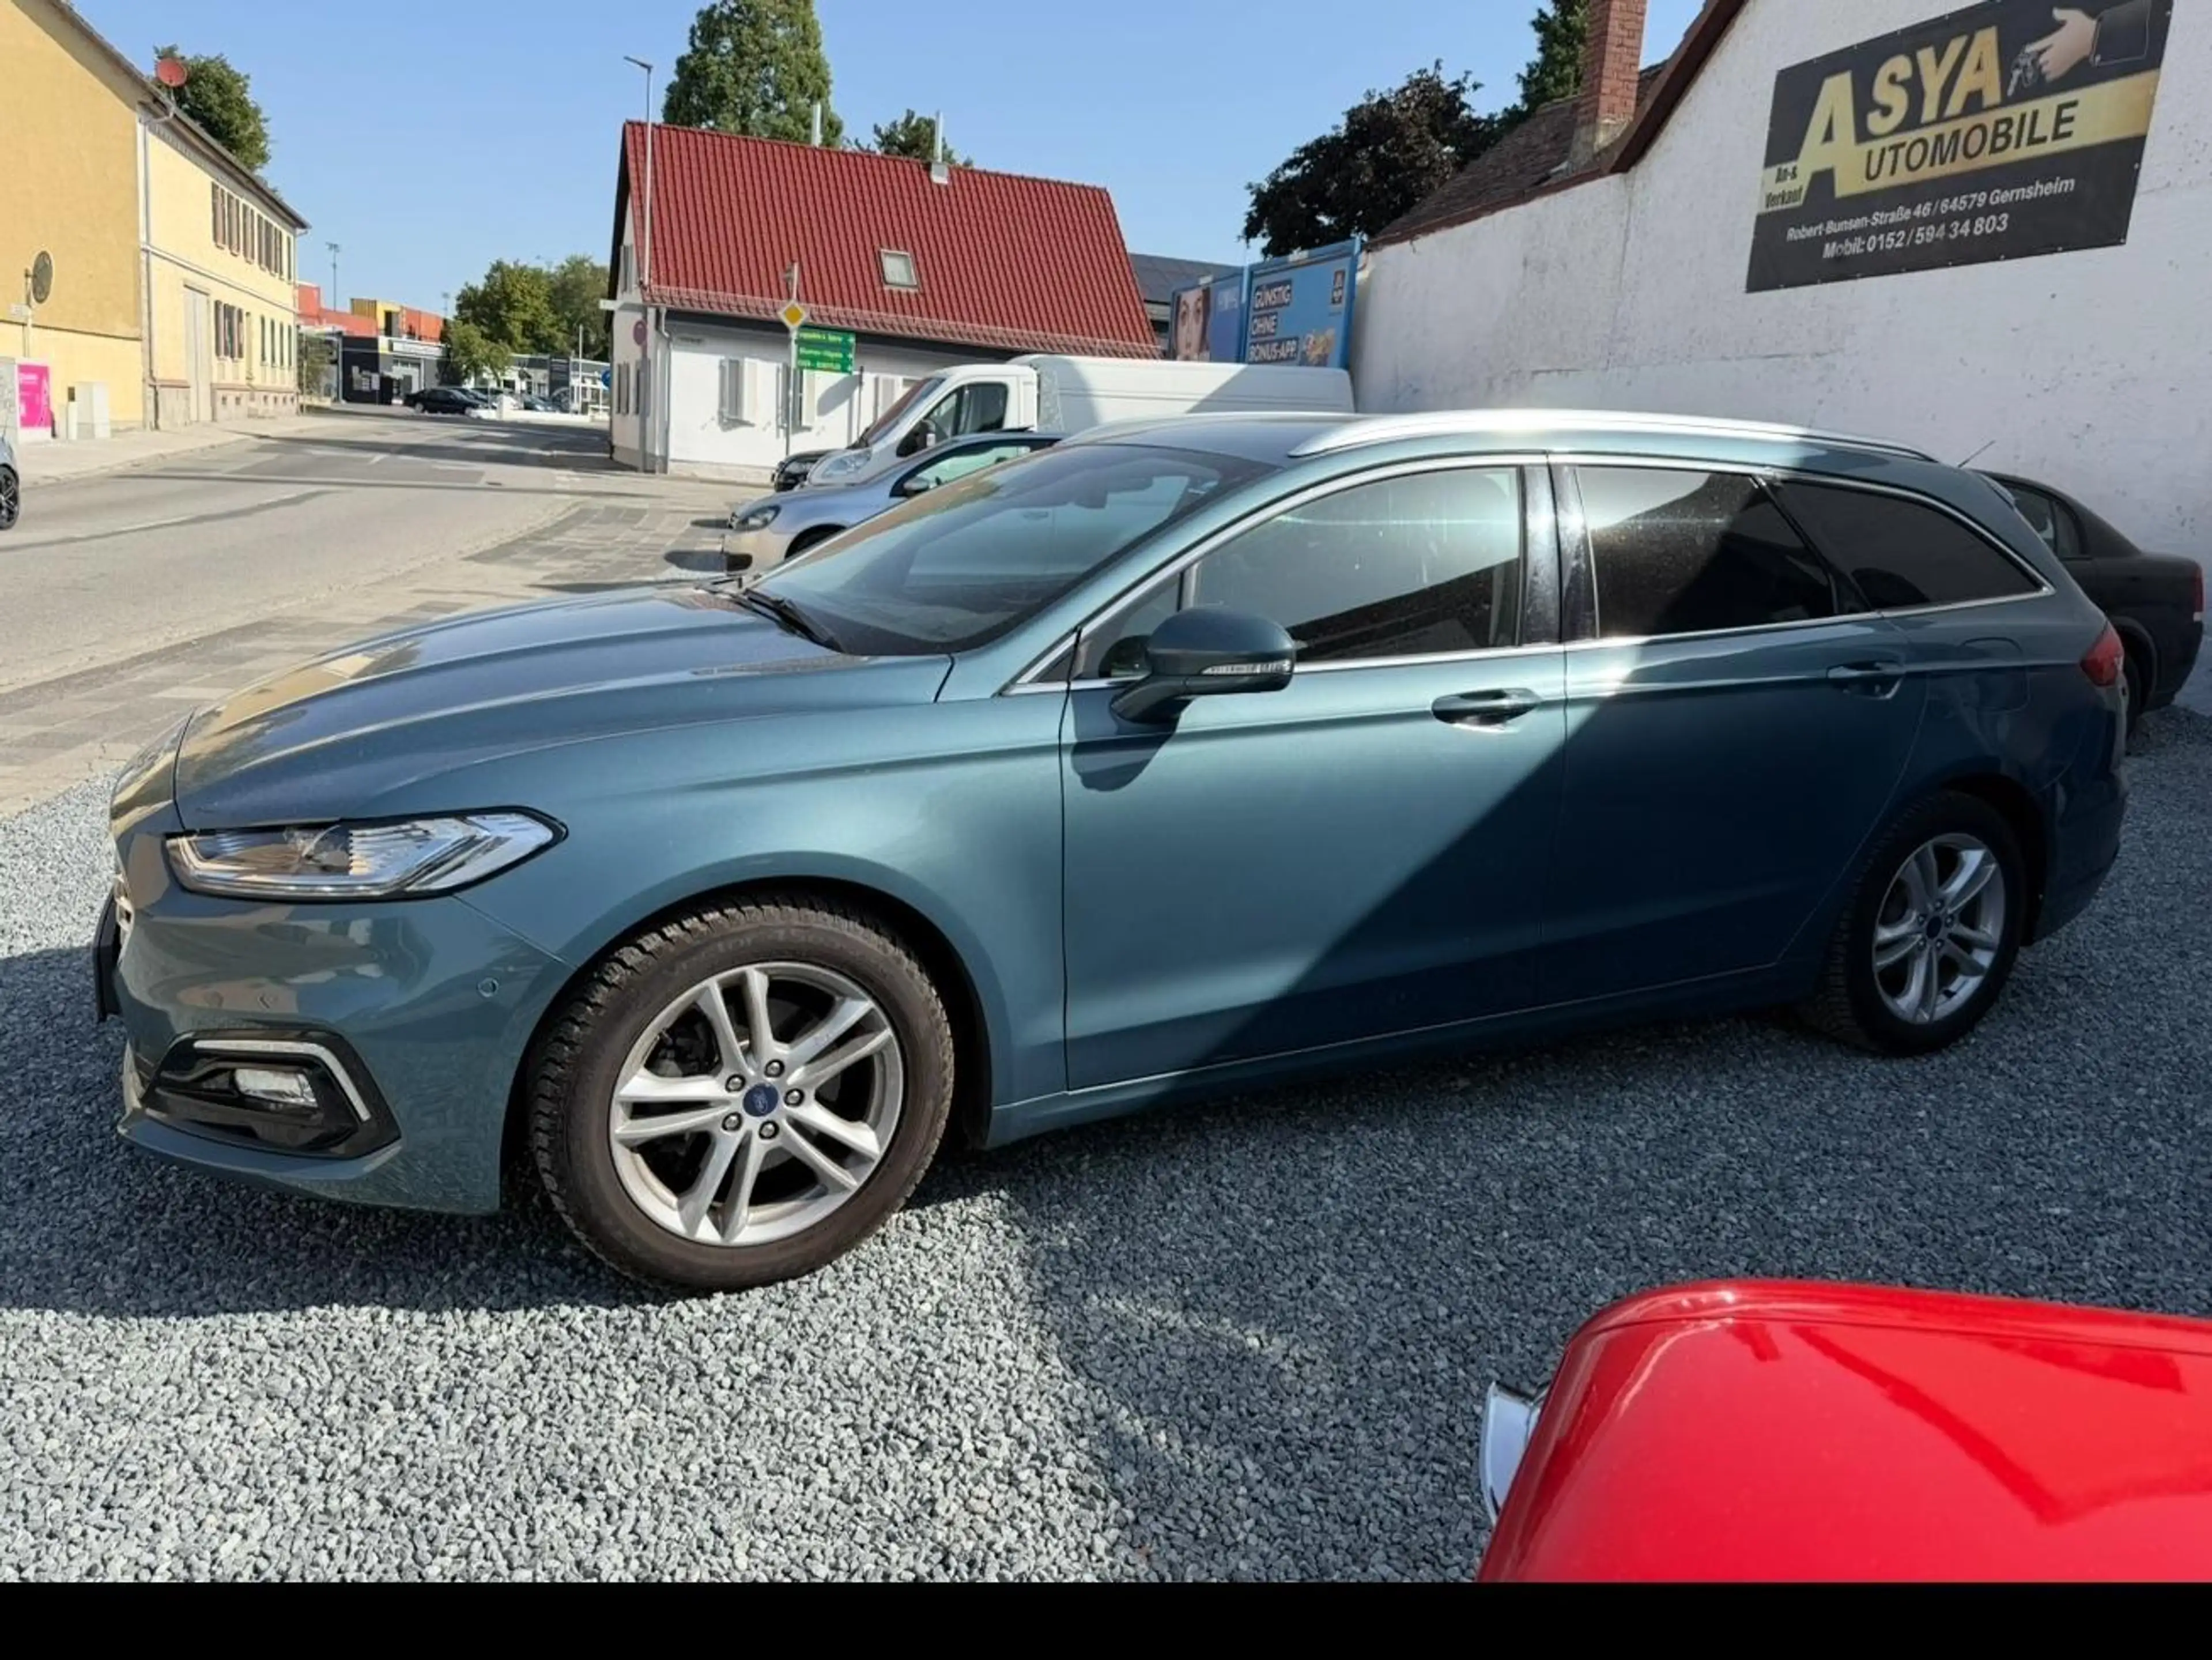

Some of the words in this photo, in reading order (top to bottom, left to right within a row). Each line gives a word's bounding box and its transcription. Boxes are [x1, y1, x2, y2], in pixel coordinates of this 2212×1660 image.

[1797, 26, 2002, 198] ASYA
[1865, 100, 2078, 181] UTOMOBILE
[1765, 184, 1803, 208] Verkauf
[1787, 205, 1911, 242] Robert-Bunsen-Straße
[1989, 176, 2075, 206] Gernsheim
[1822, 236, 1864, 258] Mobil:
[1866, 229, 1905, 252] 0152
[1949, 218, 1971, 240] 34
[1973, 213, 2010, 236] 803
[1252, 315, 1277, 335] OHNE
